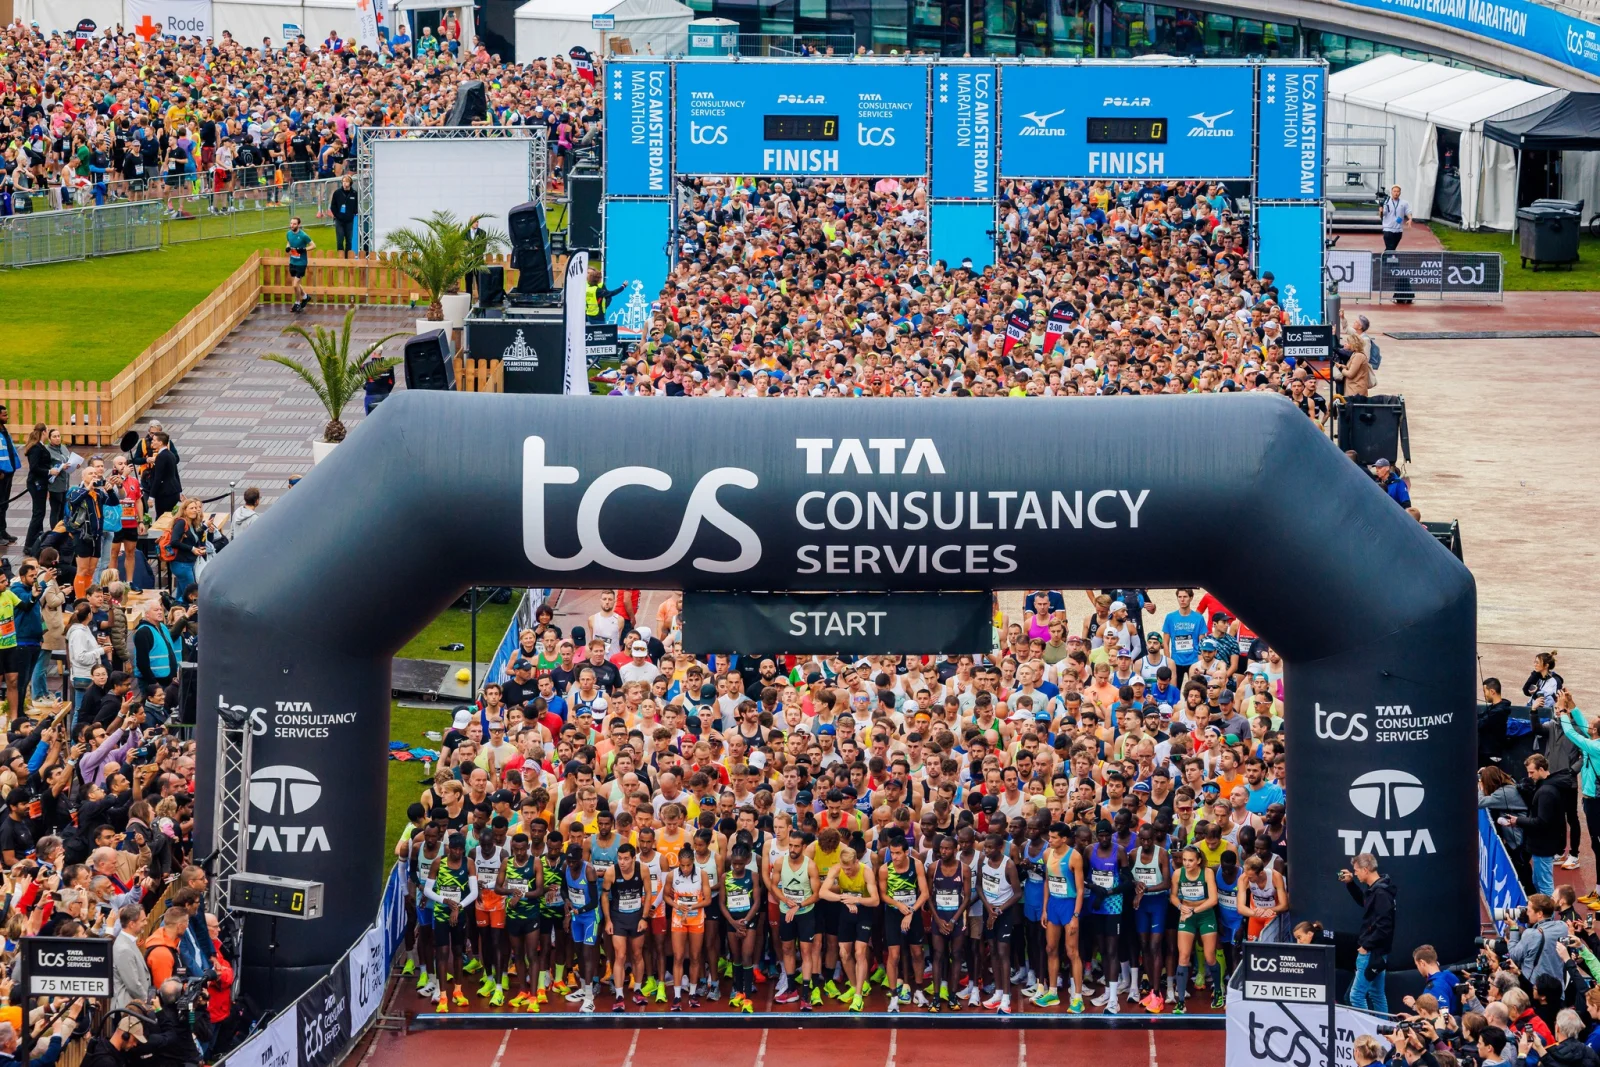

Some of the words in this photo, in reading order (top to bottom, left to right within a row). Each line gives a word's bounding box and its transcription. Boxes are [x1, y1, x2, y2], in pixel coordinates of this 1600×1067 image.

[168, 16, 204, 31] Rode
[1395, 0, 1466, 19] STERDAM
[1468, 1, 1527, 37] MARATHON
[1567, 23, 1584, 56] tcs
[649, 70, 665, 96] tcs
[975, 73, 991, 99] tcs
[1302, 74, 1319, 100] tcs
[631, 71, 645, 144] MARATHON
[777, 94, 826, 104] POLAR
[858, 102, 913, 110] CONSULTANCY
[957, 73, 971, 147] MARATHON
[1103, 97, 1151, 107] POLAR
[1284, 74, 1299, 148] MARATHON
[649, 99, 663, 190] AMSTERDAM
[691, 120, 728, 145] tcs
[858, 122, 896, 146] tcs
[974, 101, 989, 193] AMSTERDAM
[1301, 101, 1316, 194] AMSTERDAM
[763, 149, 839, 171] FINISH
[1089, 152, 1164, 174] FINISH
[1053, 308, 1074, 317] POLAR
[585, 333, 593, 341] cs
[1049, 323, 1063, 332] 3:00
[1287, 332, 1301, 341] tcs
[796, 438, 945, 474] TATA
[522, 435, 763, 573] tcs
[795, 489, 1150, 531] CONSULTANCY
[796, 544, 1018, 574] SERVICES
[788, 612, 887, 636] START
[275, 701, 312, 712] TATA
[275, 712, 357, 725] CONSULTANCY
[1376, 705, 1412, 715] TATA
[275, 728, 329, 738] SERVICES
[1314, 702, 1369, 741] tcs
[1376, 712, 1453, 730] CONSULTANCY
[1376, 729, 1429, 742] SERVICES
[233, 823, 331, 852] TATA
[1338, 829, 1436, 857] TATA
[38, 949, 65, 967] tcs
[1250, 954, 1277, 972] tcs
[41, 980, 56, 990] 75
[60, 981, 104, 991] METER
[1252, 985, 1268, 995] 75
[1272, 986, 1317, 998] METER
[1249, 1011, 1311, 1067] tcs
[1319, 1024, 1355, 1042] TTA
